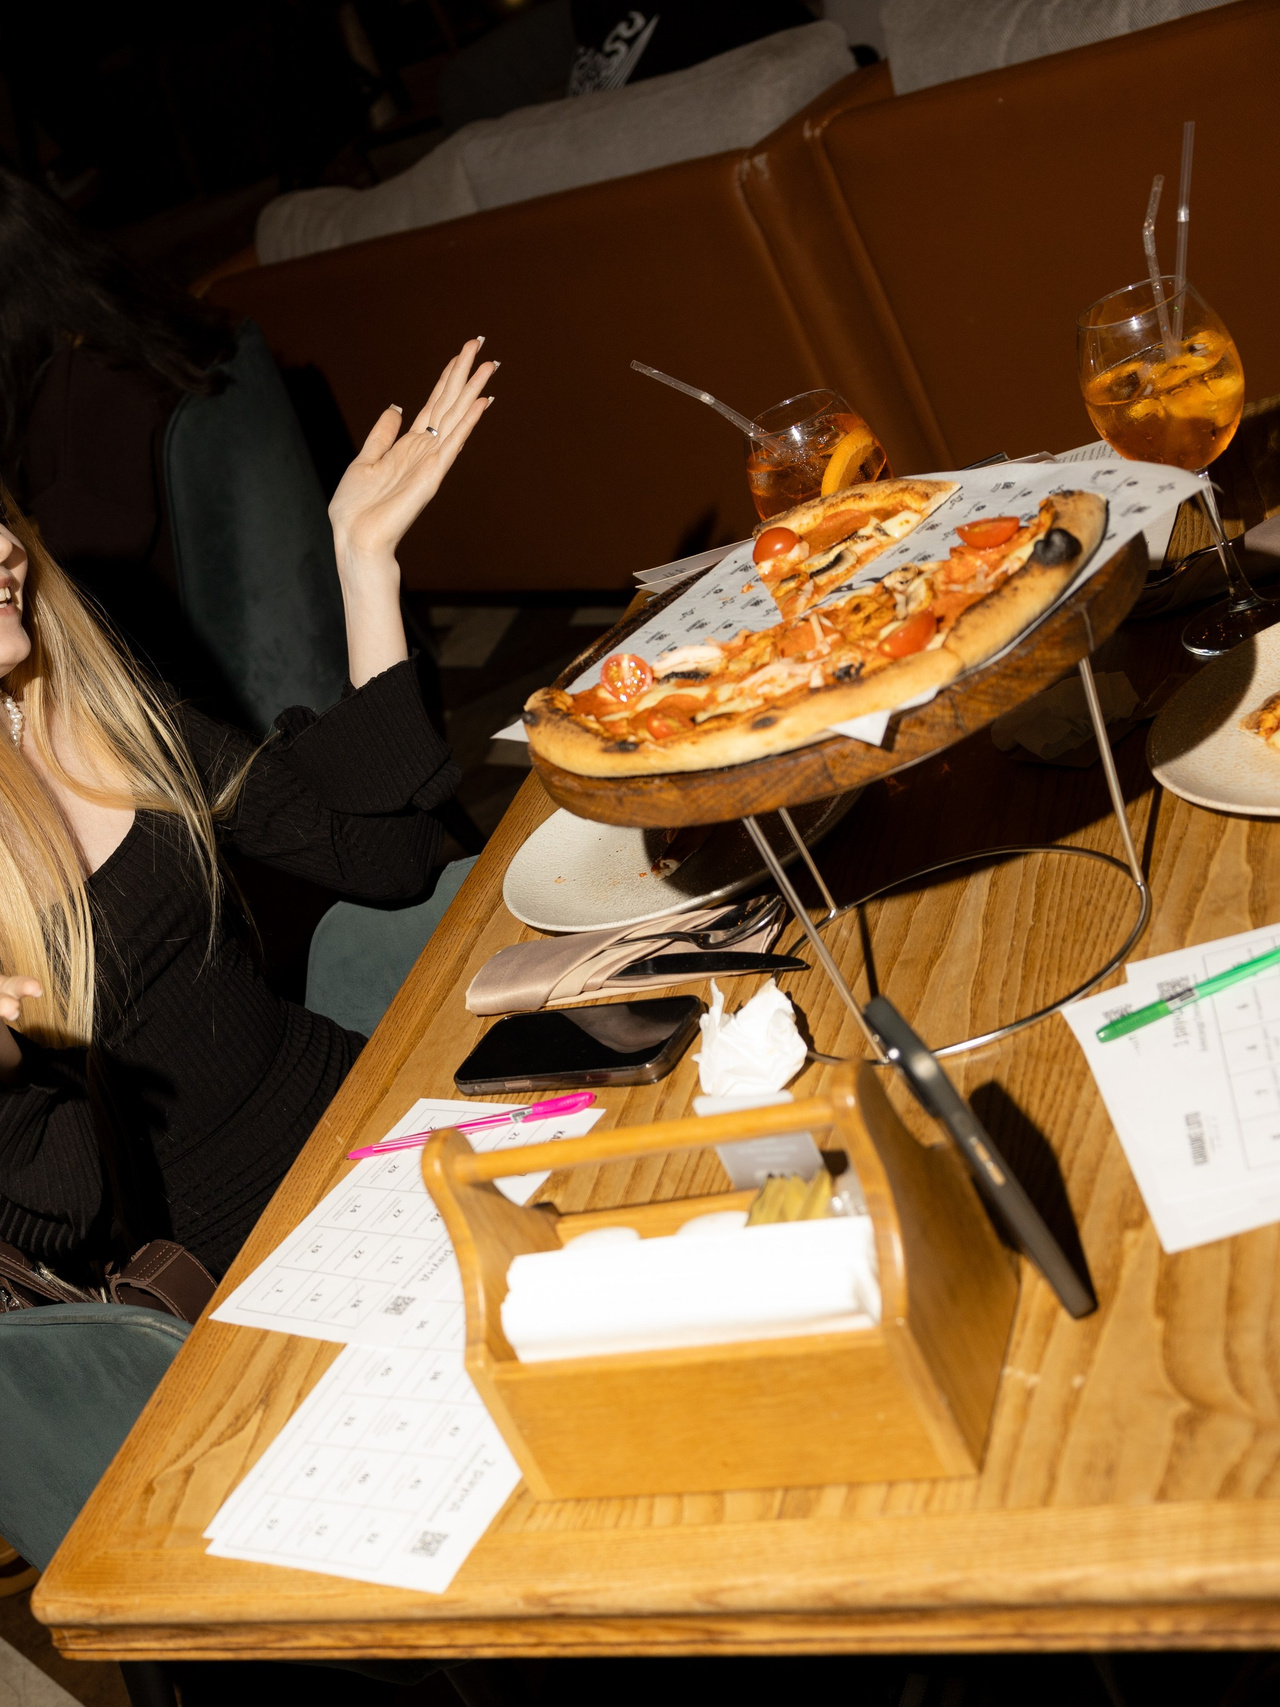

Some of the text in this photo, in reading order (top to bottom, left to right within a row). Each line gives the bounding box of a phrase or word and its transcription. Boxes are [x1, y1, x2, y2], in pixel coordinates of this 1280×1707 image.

[507, 1132, 521, 1140] 21
[387, 1165, 400, 1173] 29
[348, 1204, 362, 1213] 14
[392, 1209, 404, 1218] 27
[352, 1250, 365, 1259] 22
